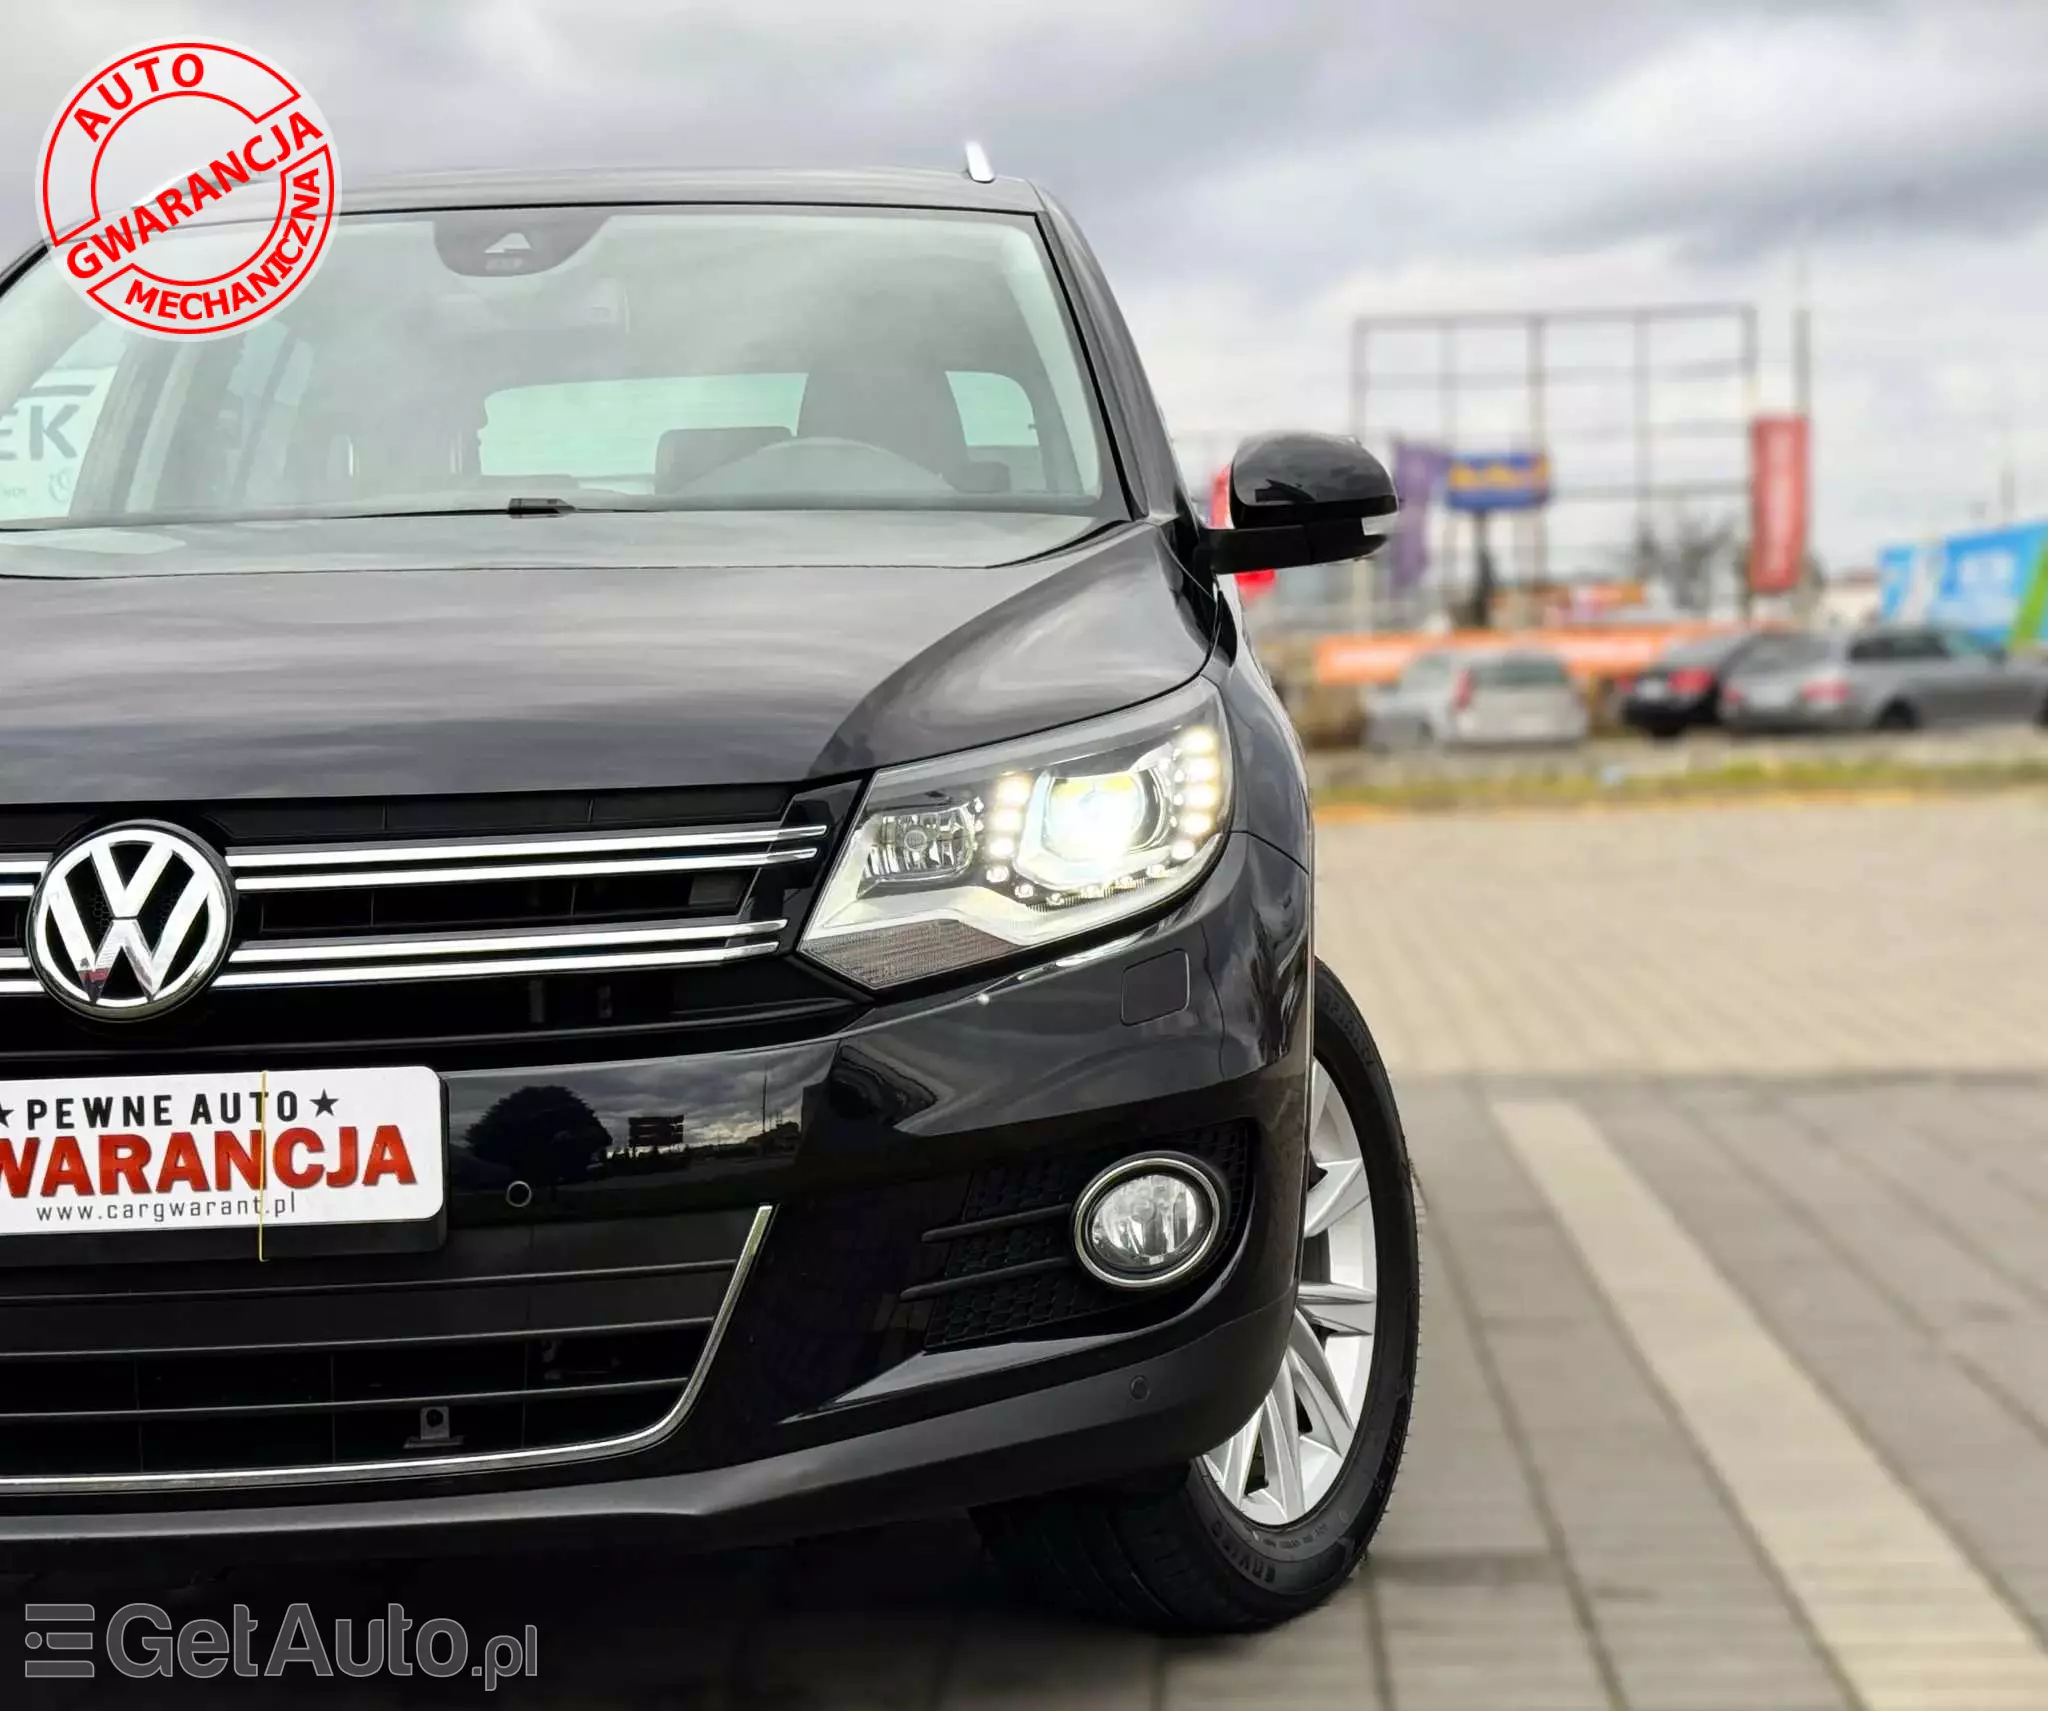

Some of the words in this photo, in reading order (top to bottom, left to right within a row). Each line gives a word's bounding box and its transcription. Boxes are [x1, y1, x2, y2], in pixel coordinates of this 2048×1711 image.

[27, 1094, 173, 1130] PEWNE
[190, 1090, 298, 1125] AUTO
[37, 1192, 295, 1222] www.cargwarant.pl
